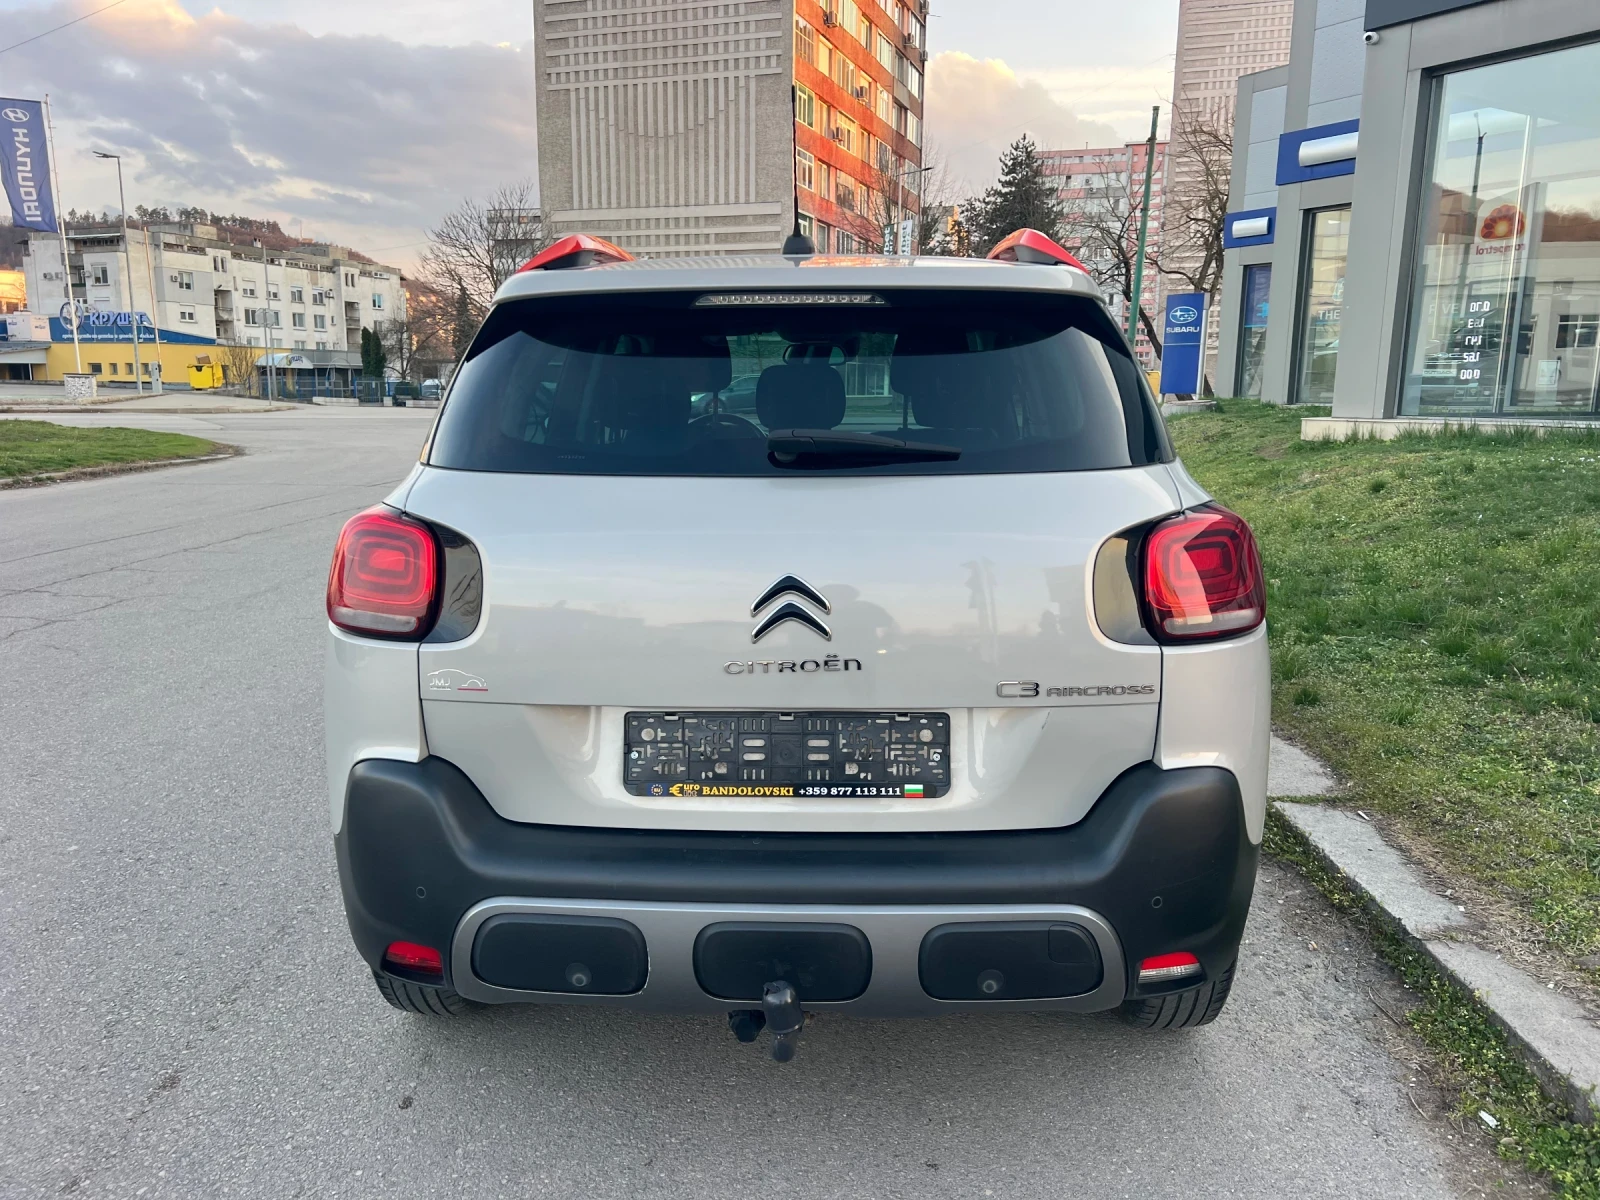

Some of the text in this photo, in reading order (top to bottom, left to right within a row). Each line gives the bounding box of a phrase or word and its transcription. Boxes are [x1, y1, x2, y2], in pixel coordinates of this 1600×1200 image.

[1318, 310, 1341, 320] THE
[997, 680, 1155, 698] C3 AIRCROSS
[702, 786, 902, 796] BANDOLOVSKI +359 877 113 111
